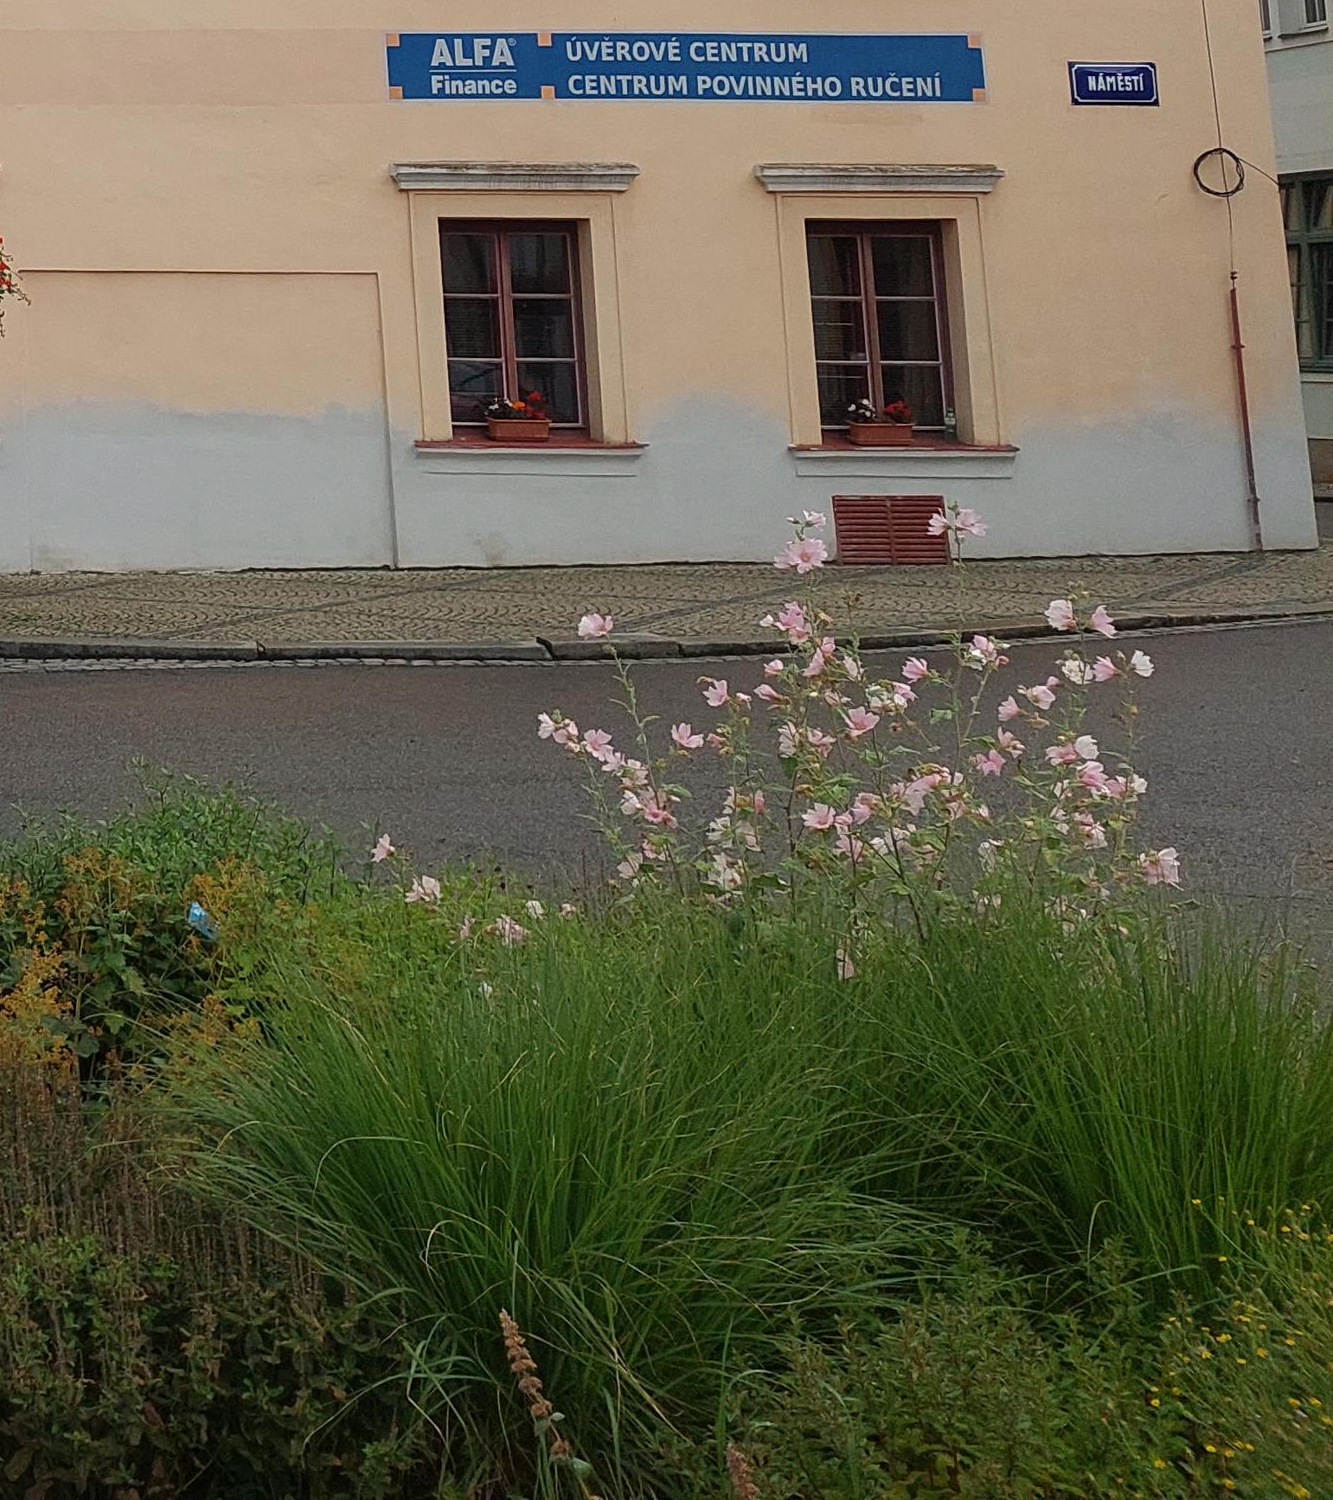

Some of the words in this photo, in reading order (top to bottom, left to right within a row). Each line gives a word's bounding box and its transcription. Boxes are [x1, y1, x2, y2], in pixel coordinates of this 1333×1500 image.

[565, 36, 682, 62] ÚVĚROVÉ
[689, 41, 809, 64] CENTRUM
[431, 75, 517, 95] Finance
[567, 74, 689, 96] CENTRUM
[696, 72, 842, 97] POVINNÉHO
[850, 72, 942, 98] RUČENÍ
[1087, 73, 1145, 92] NÁMĚSTÍ
